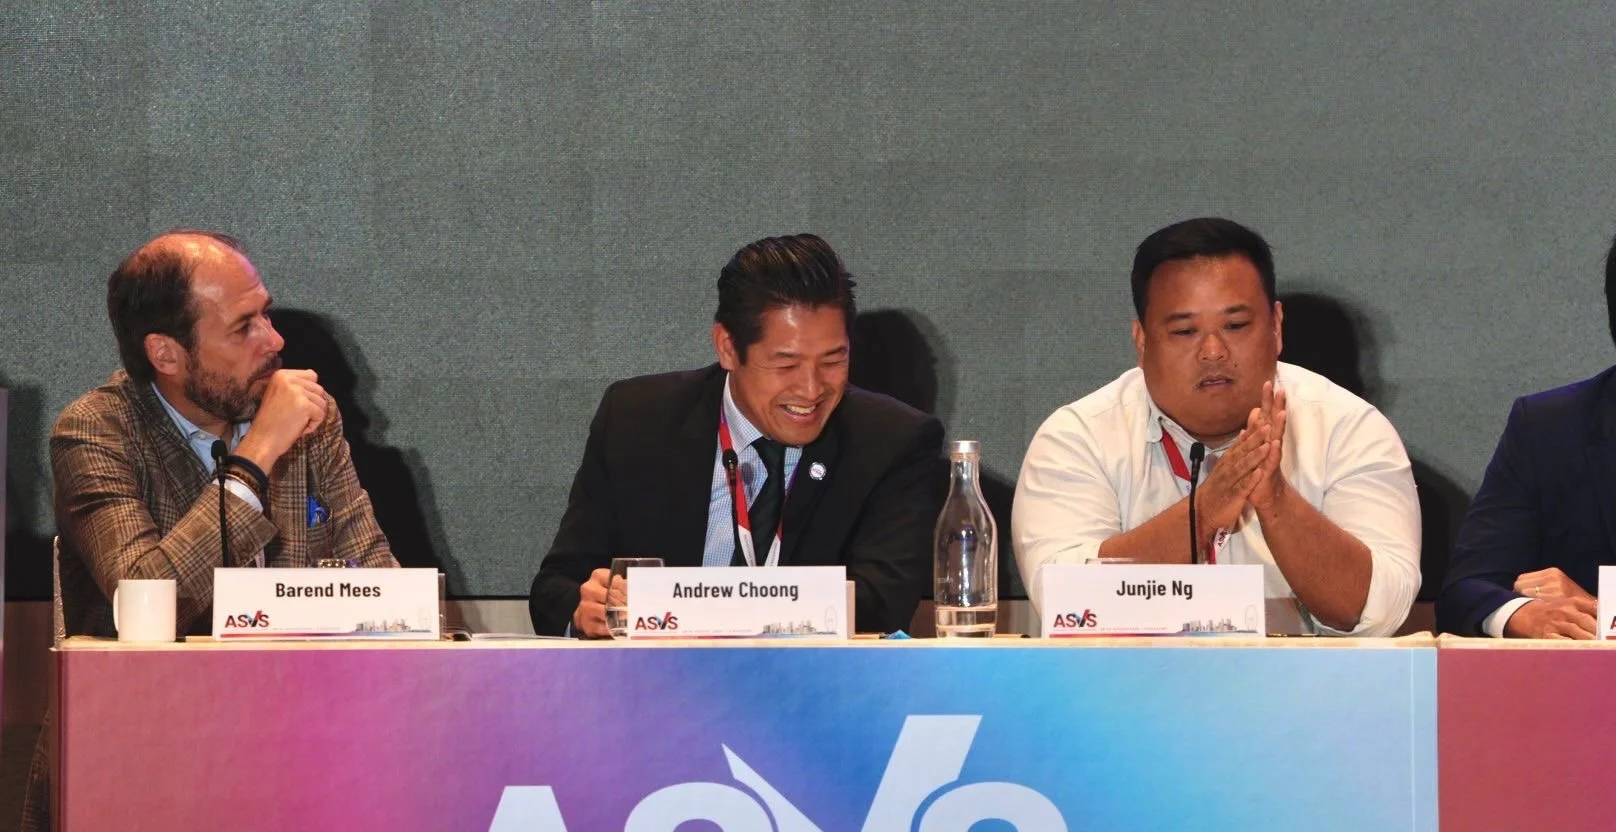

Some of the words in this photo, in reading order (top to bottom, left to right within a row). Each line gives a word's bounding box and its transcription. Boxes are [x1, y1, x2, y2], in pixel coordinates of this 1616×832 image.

[276, 582, 334, 598] Barend
[340, 582, 381, 598] Mees
[673, 582, 733, 598] Andrew
[739, 581, 799, 601] Choong
[1116, 580, 1166, 599] Junjie
[1172, 580, 1193, 599] Ng
[225, 610, 270, 628] ASVS
[635, 611, 679, 630] ASVS
[1053, 609, 1097, 628] ASVS
